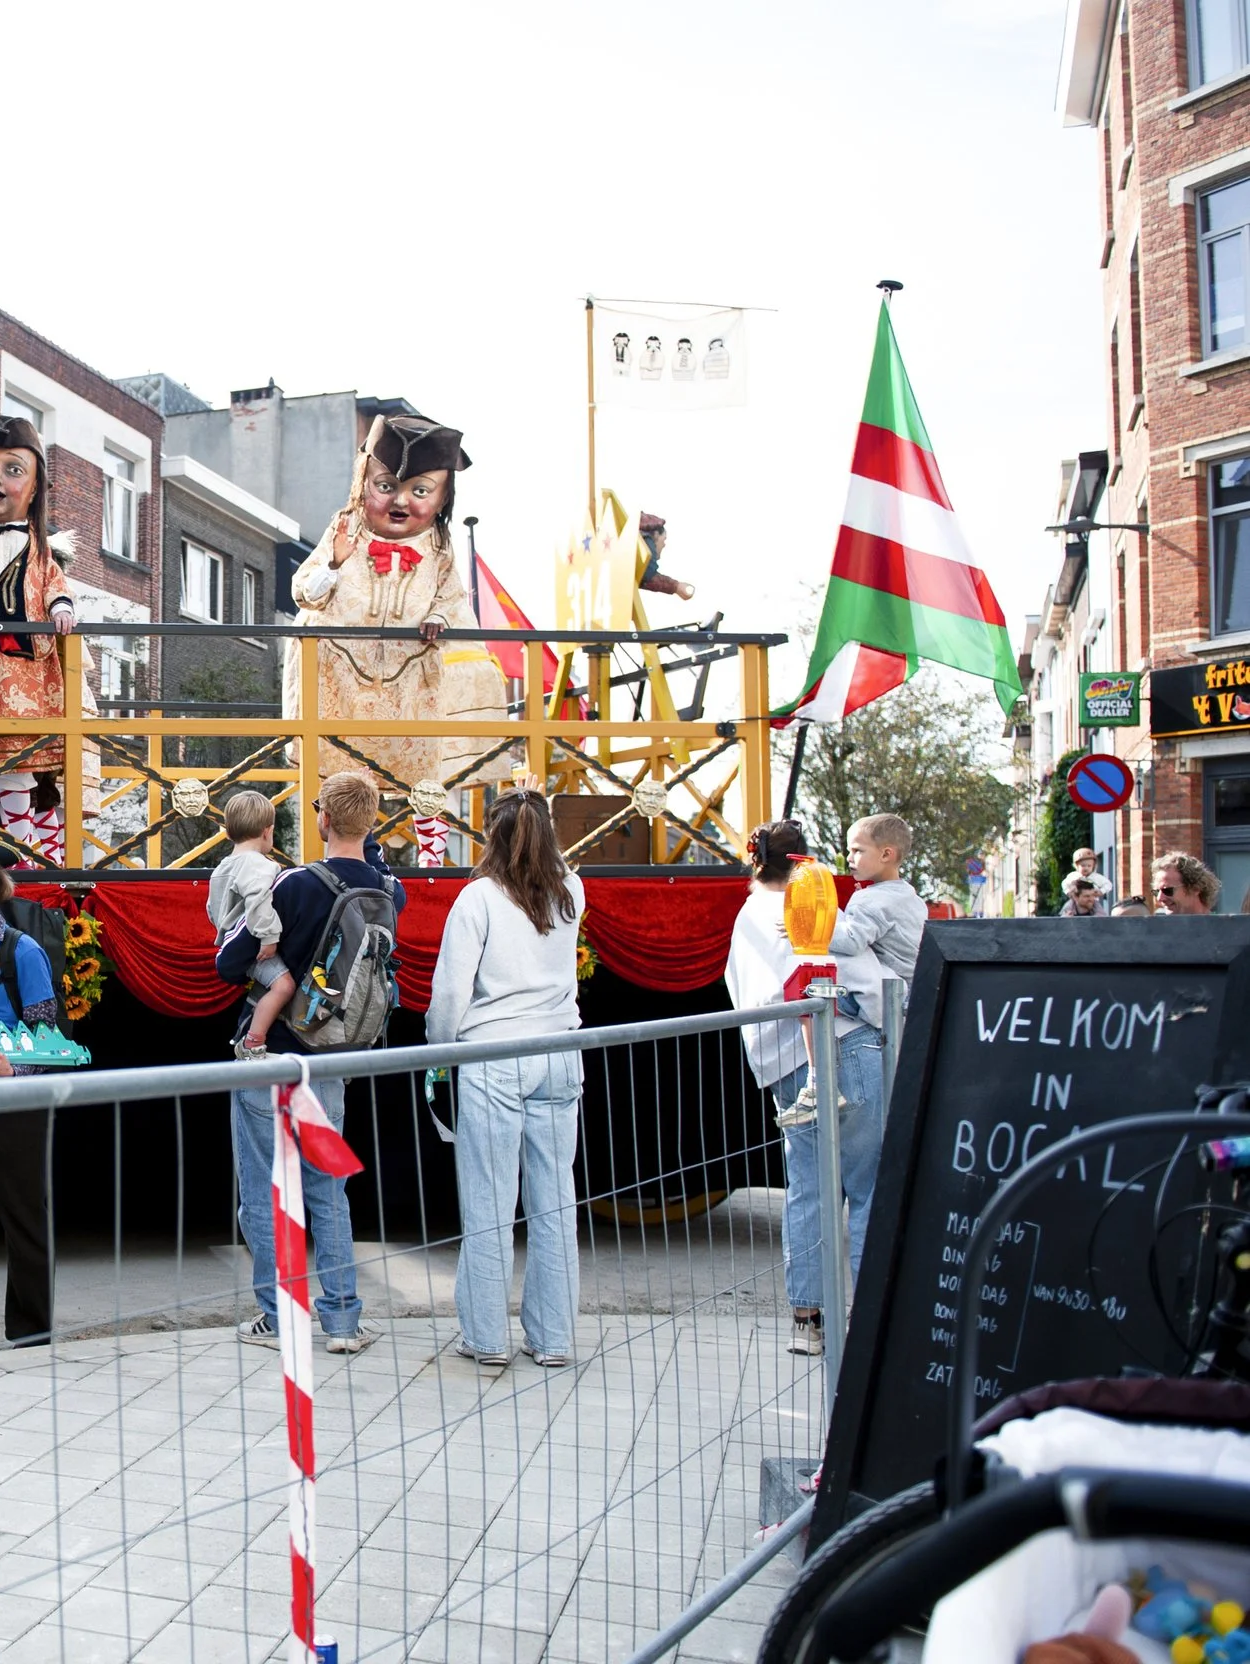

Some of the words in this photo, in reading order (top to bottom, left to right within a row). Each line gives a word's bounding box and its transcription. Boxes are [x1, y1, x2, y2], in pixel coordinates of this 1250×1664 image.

[567, 560, 612, 631] 314
[1086, 699, 1133, 709] OFFICIAL
[1090, 708, 1130, 718] DEALER
[976, 997, 1166, 1053] WELKOM
[1031, 1072, 1073, 1111] IN
[1033, 1284, 1055, 1302] VAN
[926, 1362, 1003, 1399] ZATDAG
